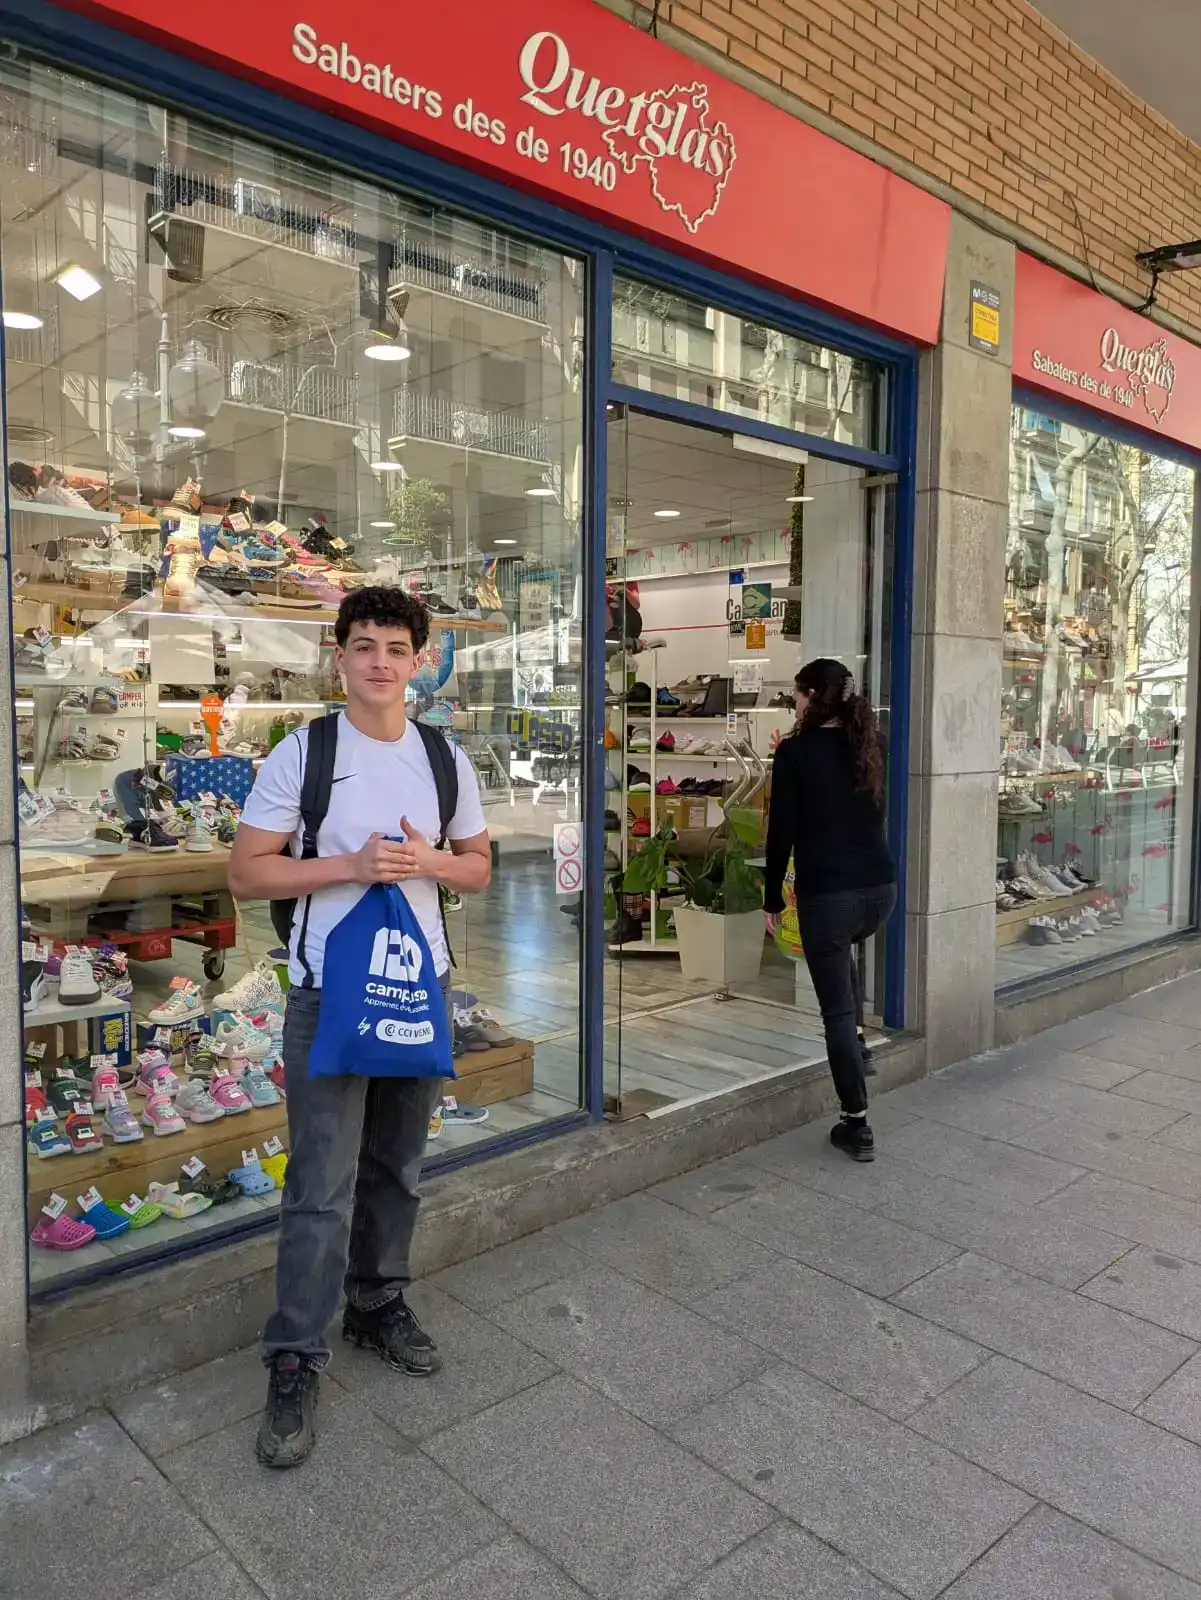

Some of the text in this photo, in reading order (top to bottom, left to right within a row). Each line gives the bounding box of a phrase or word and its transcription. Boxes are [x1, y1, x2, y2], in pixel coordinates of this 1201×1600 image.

[291, 22, 617, 192] Sabaters des de 1940
[1033, 349, 1134, 408] Sabaters des de 1940
[357, 1016, 371, 1035] by
[397, 1027, 413, 1038] CCI
